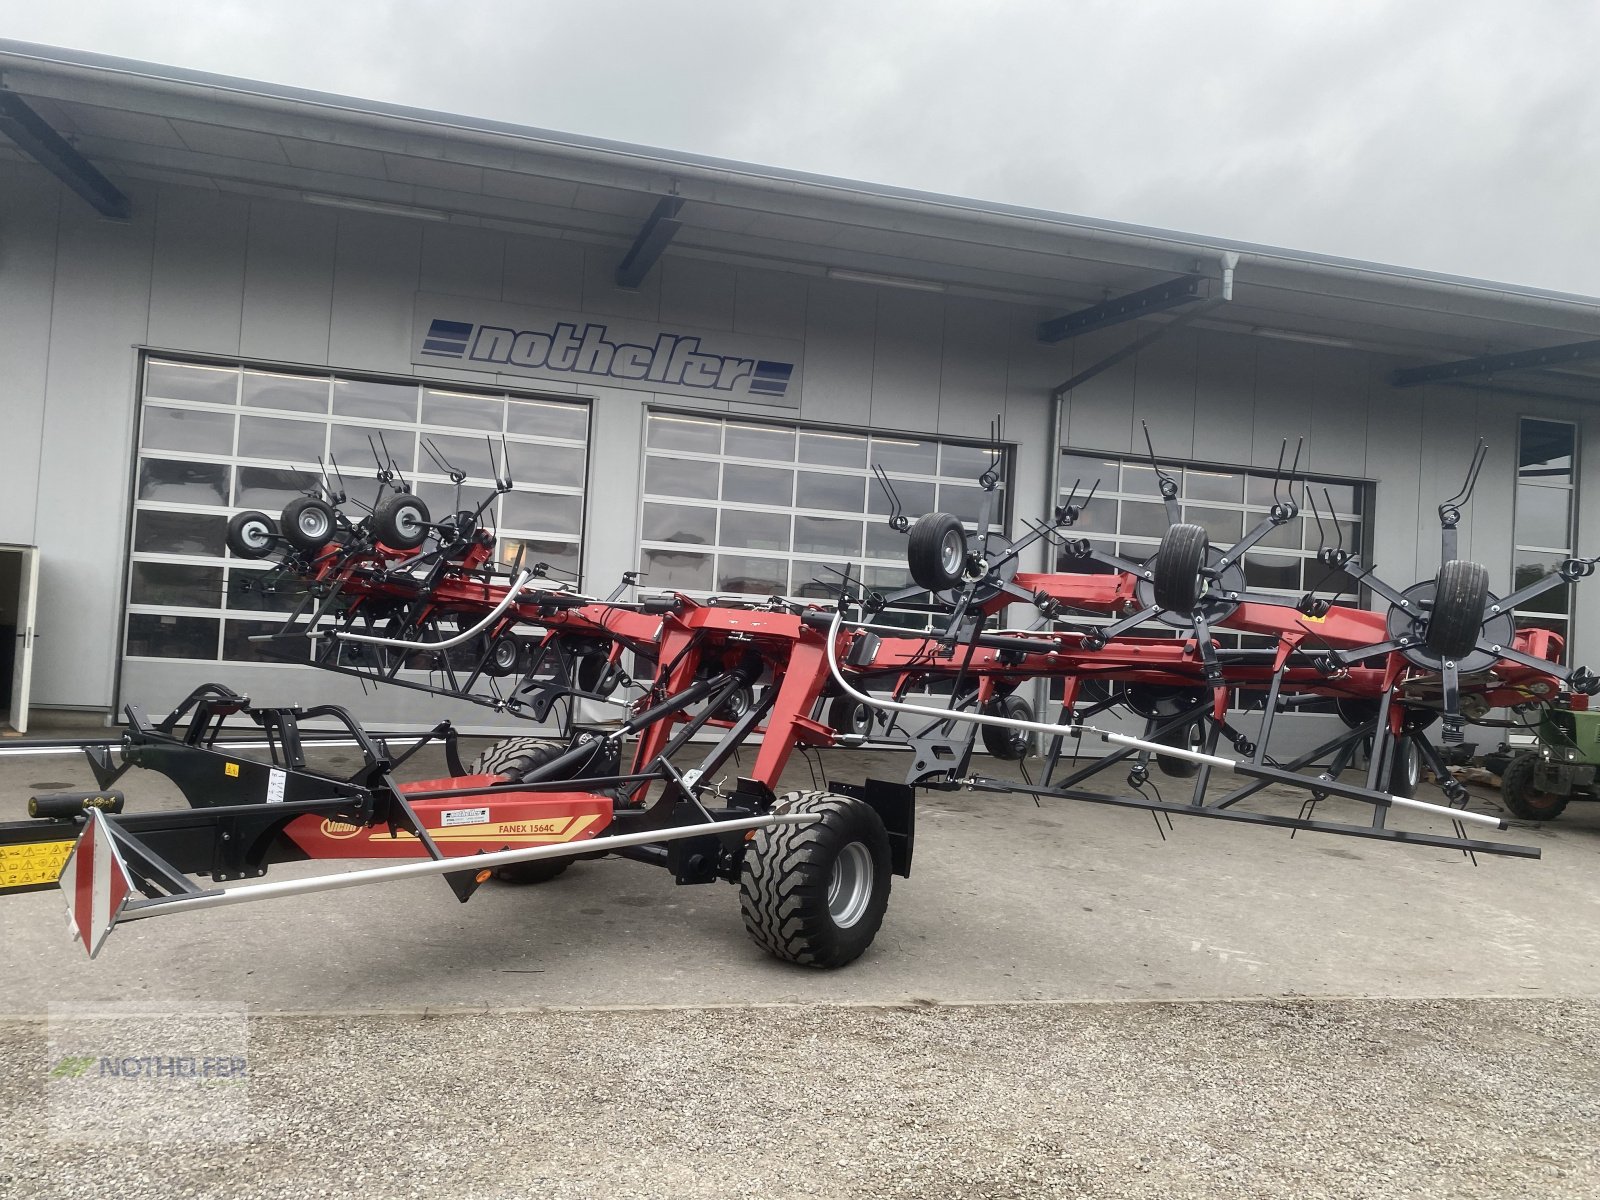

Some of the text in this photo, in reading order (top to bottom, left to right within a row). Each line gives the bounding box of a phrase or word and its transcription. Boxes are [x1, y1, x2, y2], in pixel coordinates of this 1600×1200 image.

[468, 322, 755, 392] nothelfer
[499, 824, 555, 833] FANEX 1564C
